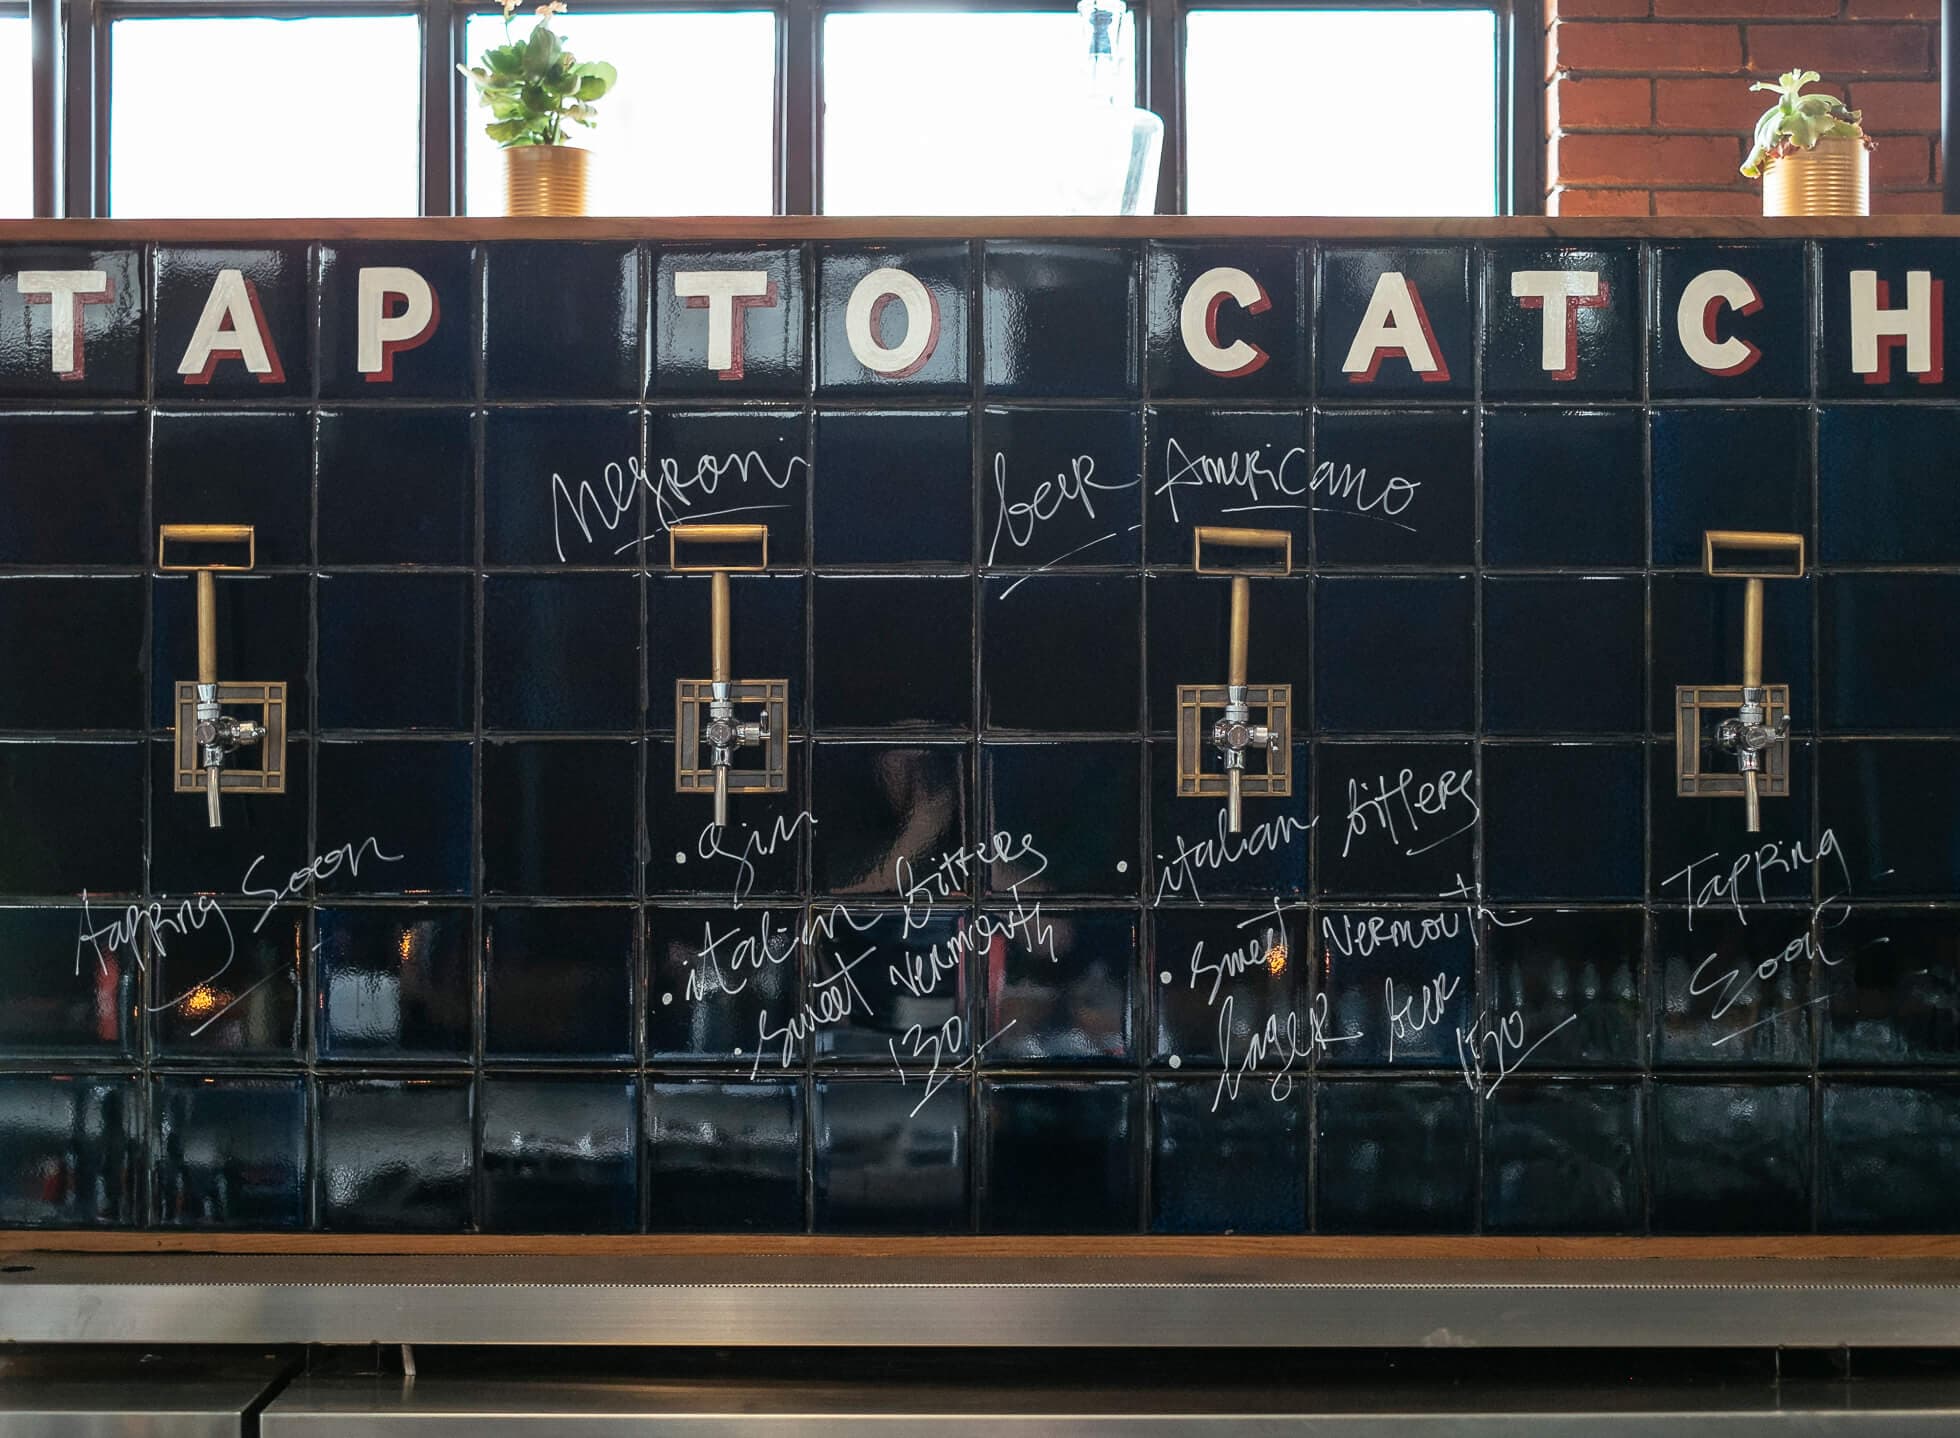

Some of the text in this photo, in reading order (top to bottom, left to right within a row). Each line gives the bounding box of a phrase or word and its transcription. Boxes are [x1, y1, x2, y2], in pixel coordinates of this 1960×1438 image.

[17, 266, 1945, 384] TAP TO CATCH
